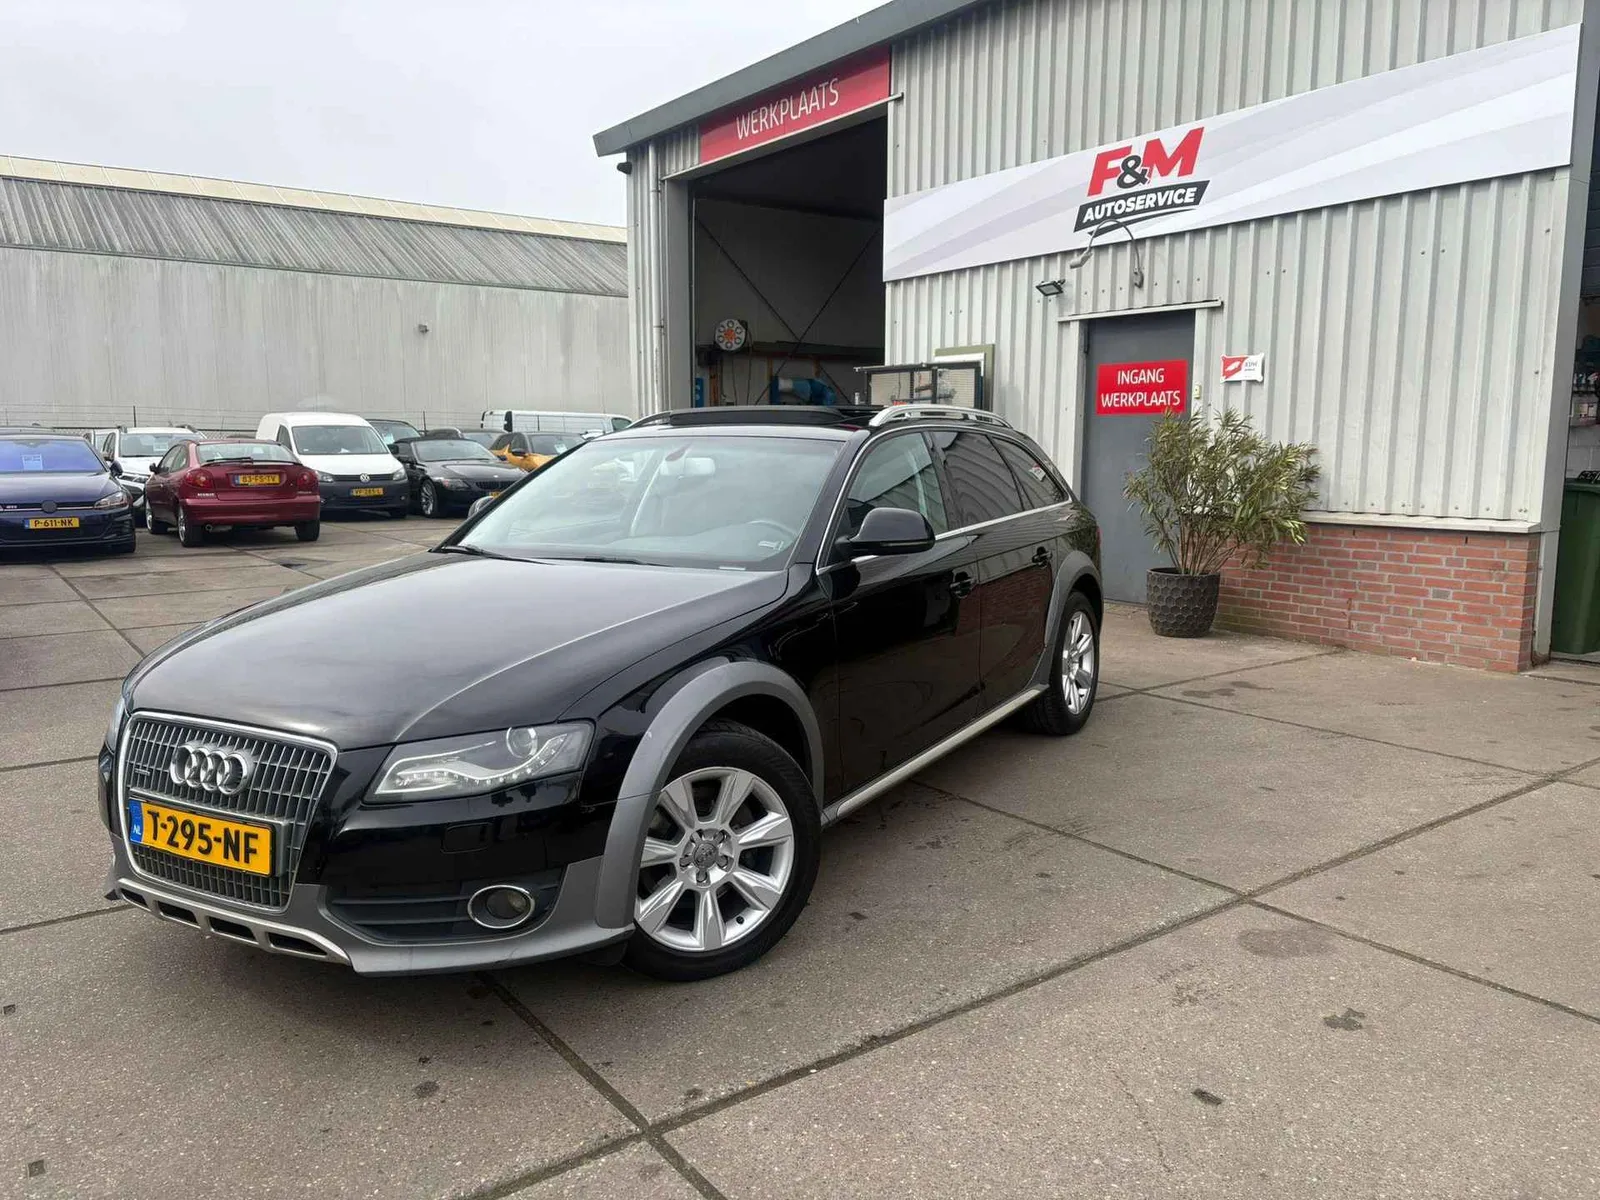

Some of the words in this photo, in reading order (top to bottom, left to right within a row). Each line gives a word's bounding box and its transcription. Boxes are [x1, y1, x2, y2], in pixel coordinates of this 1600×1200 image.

[736, 78, 839, 140] WERKPLAATS
[1087, 127, 1204, 197] F&M
[1082, 187, 1197, 223] AUTOSERVICE
[1117, 367, 1165, 385] INGANG
[1101, 390, 1180, 407] WERKPLAATS
[34, 518, 74, 528] P-611-NK
[132, 825, 142, 835] NL
[147, 810, 259, 864] T-295-NF
